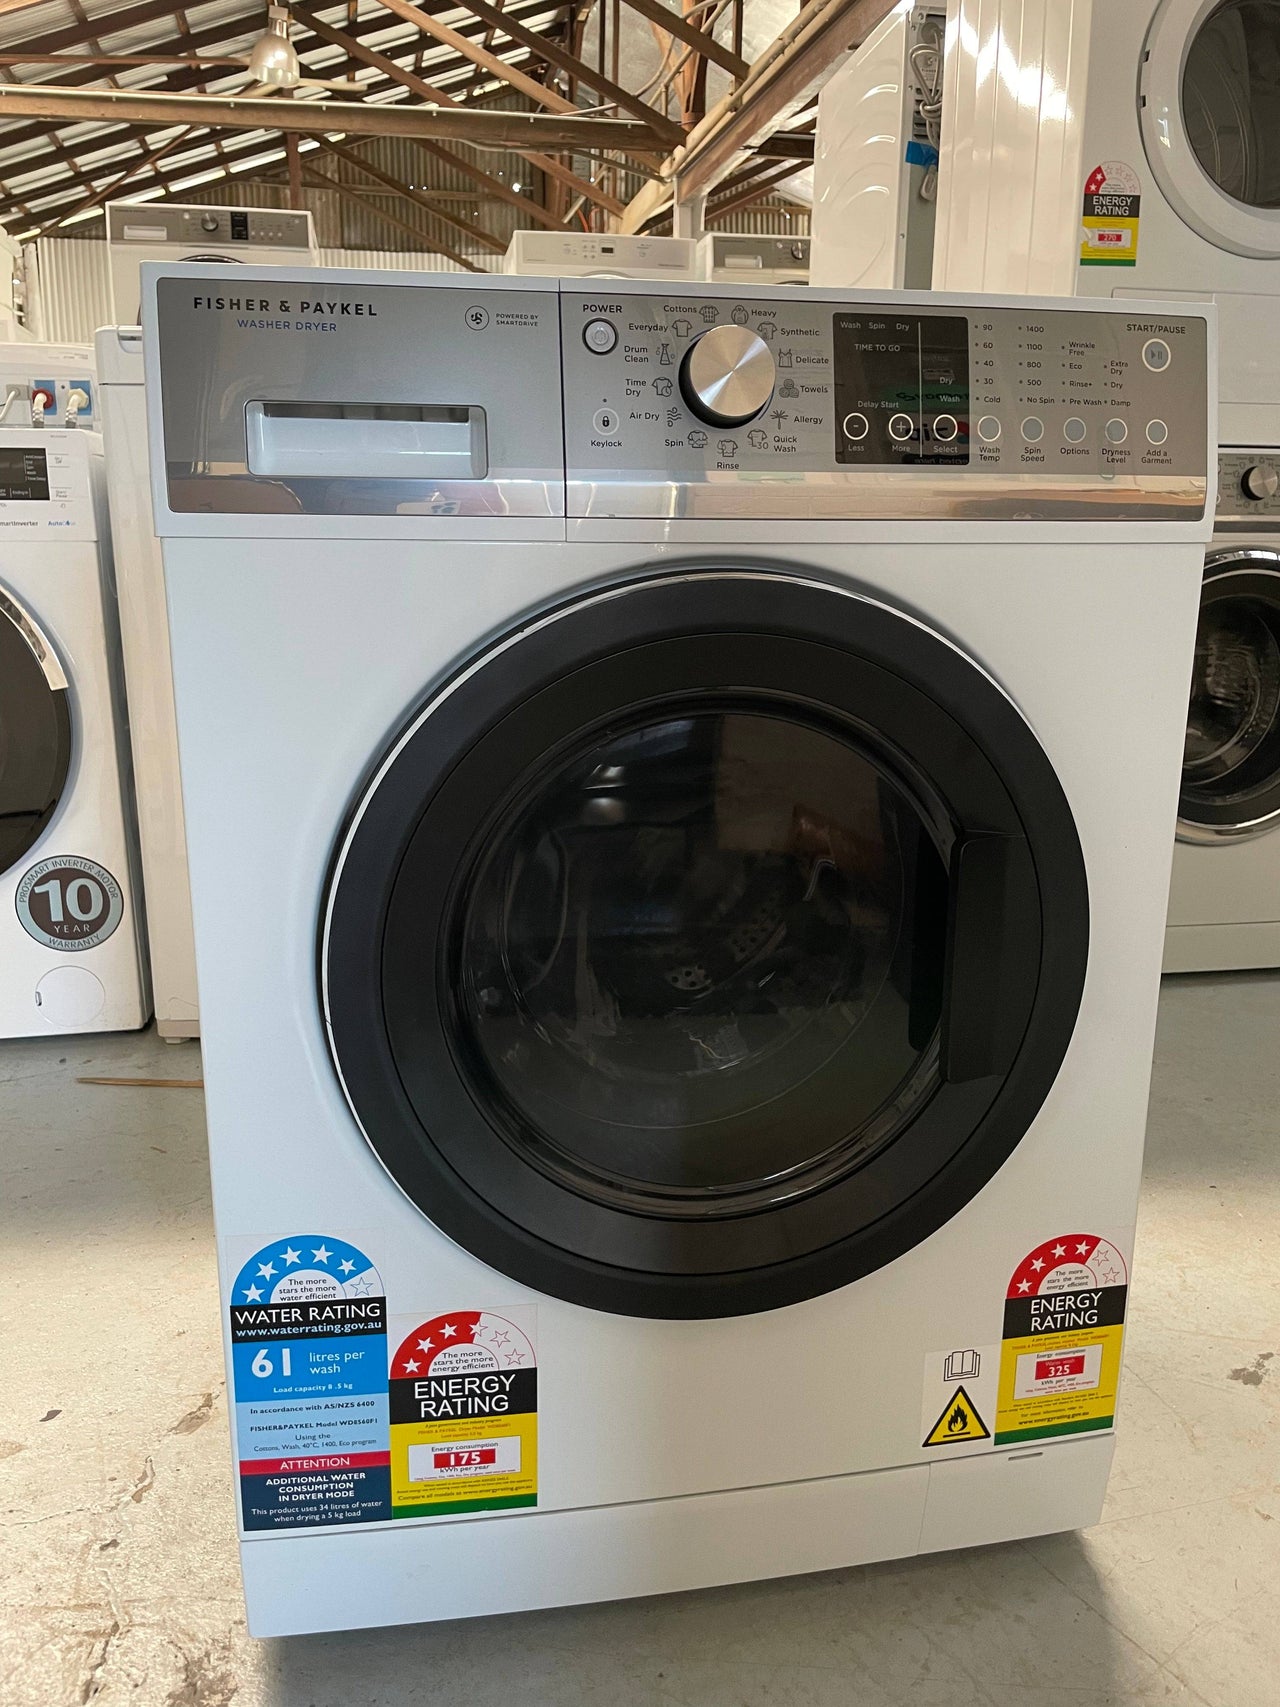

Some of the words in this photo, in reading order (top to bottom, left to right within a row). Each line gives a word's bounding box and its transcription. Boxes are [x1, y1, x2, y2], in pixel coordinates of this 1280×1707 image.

[1093, 196, 1132, 206] ENERGY
[1095, 206, 1129, 215] RATING
[193, 297, 270, 312] FISHER
[279, 300, 290, 313] &
[300, 301, 377, 316] PAYKEL
[583, 304, 622, 313] POWER
[664, 305, 697, 313] Cottons
[752, 309, 776, 318] Heavy
[237, 319, 290, 330] WASHER
[296, 322, 337, 332] DRYER
[629, 323, 668, 332] Everyday
[896, 323, 909, 331] Dry
[1127, 324, 1185, 334] START/PAUSE
[781, 328, 819, 336] Synthetic
[625, 355, 648, 363] Clean
[796, 356, 829, 364] Delicate
[626, 388, 641, 397] Dry
[630, 412, 641, 420] Air
[645, 413, 659, 421] Dry
[794, 416, 823, 425] Allergy
[591, 440, 622, 448] Keylock
[665, 439, 683, 448] Spin
[774, 435, 797, 444] Quick
[774, 444, 796, 452] Wash
[1102, 448, 1130, 456] Dryness
[980, 454, 1000, 462] Temp
[717, 462, 739, 470] Rinse
[52, 859, 94, 872] INVERTER
[19, 864, 49, 903] PROSMART
[95, 870, 118, 899] MOTOR
[34, 878, 103, 921] 10
[54, 924, 90, 933] YEAR
[49, 934, 100, 948] WARRANTY
[1031, 1292, 1102, 1314] ENERGY
[235, 1308, 303, 1324] WATER
[309, 1304, 380, 1320] RATING
[1031, 1310, 1098, 1331] RATING
[236, 1322, 381, 1336] www.waterrating.gov.au
[310, 1352, 340, 1362] litres
[345, 1351, 365, 1363] per
[252, 1348, 291, 1378] 61
[310, 1364, 340, 1374] wash
[1048, 1365, 1070, 1376] 325
[415, 1374, 515, 1399] ENERGY
[421, 1395, 509, 1418] RATING
[250, 1423, 314, 1431] FISHER&PAYKEL
[456, 1442, 498, 1450] consumption
[450, 1452, 480, 1465] 175
[280, 1457, 350, 1470] ATTENTION
[266, 1475, 328, 1485] ADDITIONAL
[331, 1473, 365, 1481] WATER
[279, 1483, 353, 1493] CONSUMPTION
[326, 1490, 354, 1498] MODE
[269, 1507, 298, 1516] product
[296, 1514, 319, 1522] drying
